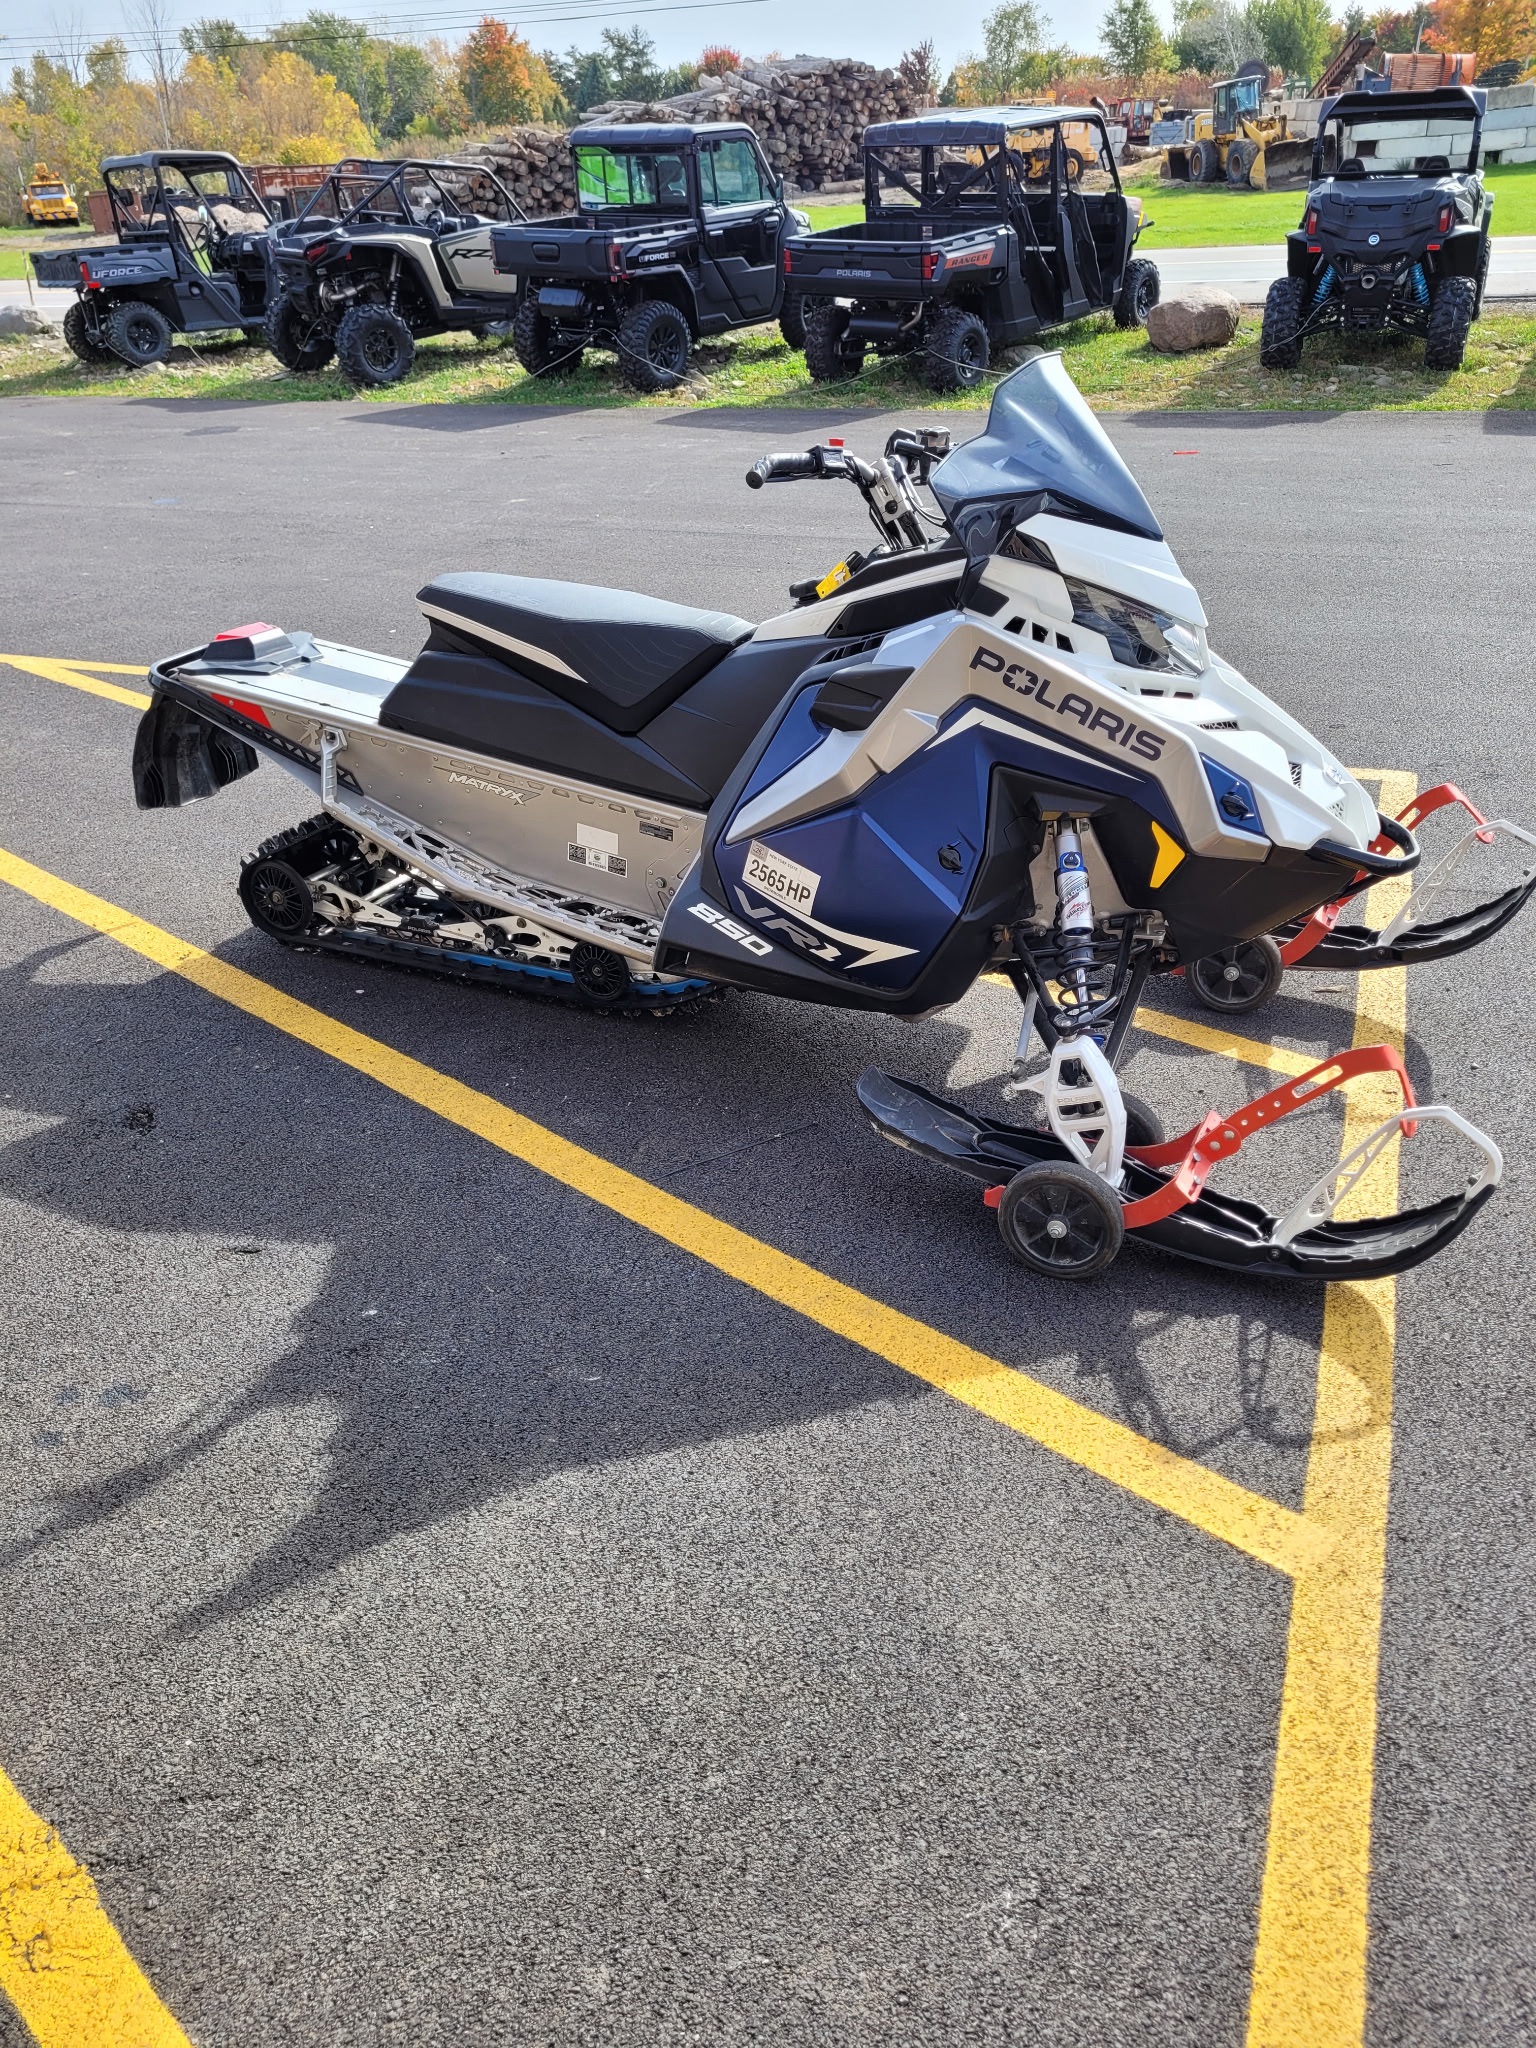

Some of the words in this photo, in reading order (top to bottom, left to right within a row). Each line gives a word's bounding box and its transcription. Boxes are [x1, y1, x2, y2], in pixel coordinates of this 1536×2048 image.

[836, 269, 872, 278] POLARIS
[951, 253, 989, 267] RANGER
[969, 645, 1167, 762] POLARIS
[448, 771, 525, 806] MATRYX
[686, 902, 774, 957] 850
[733, 884, 842, 962] VR1
[1056, 1093, 1099, 1104] POLARIS
